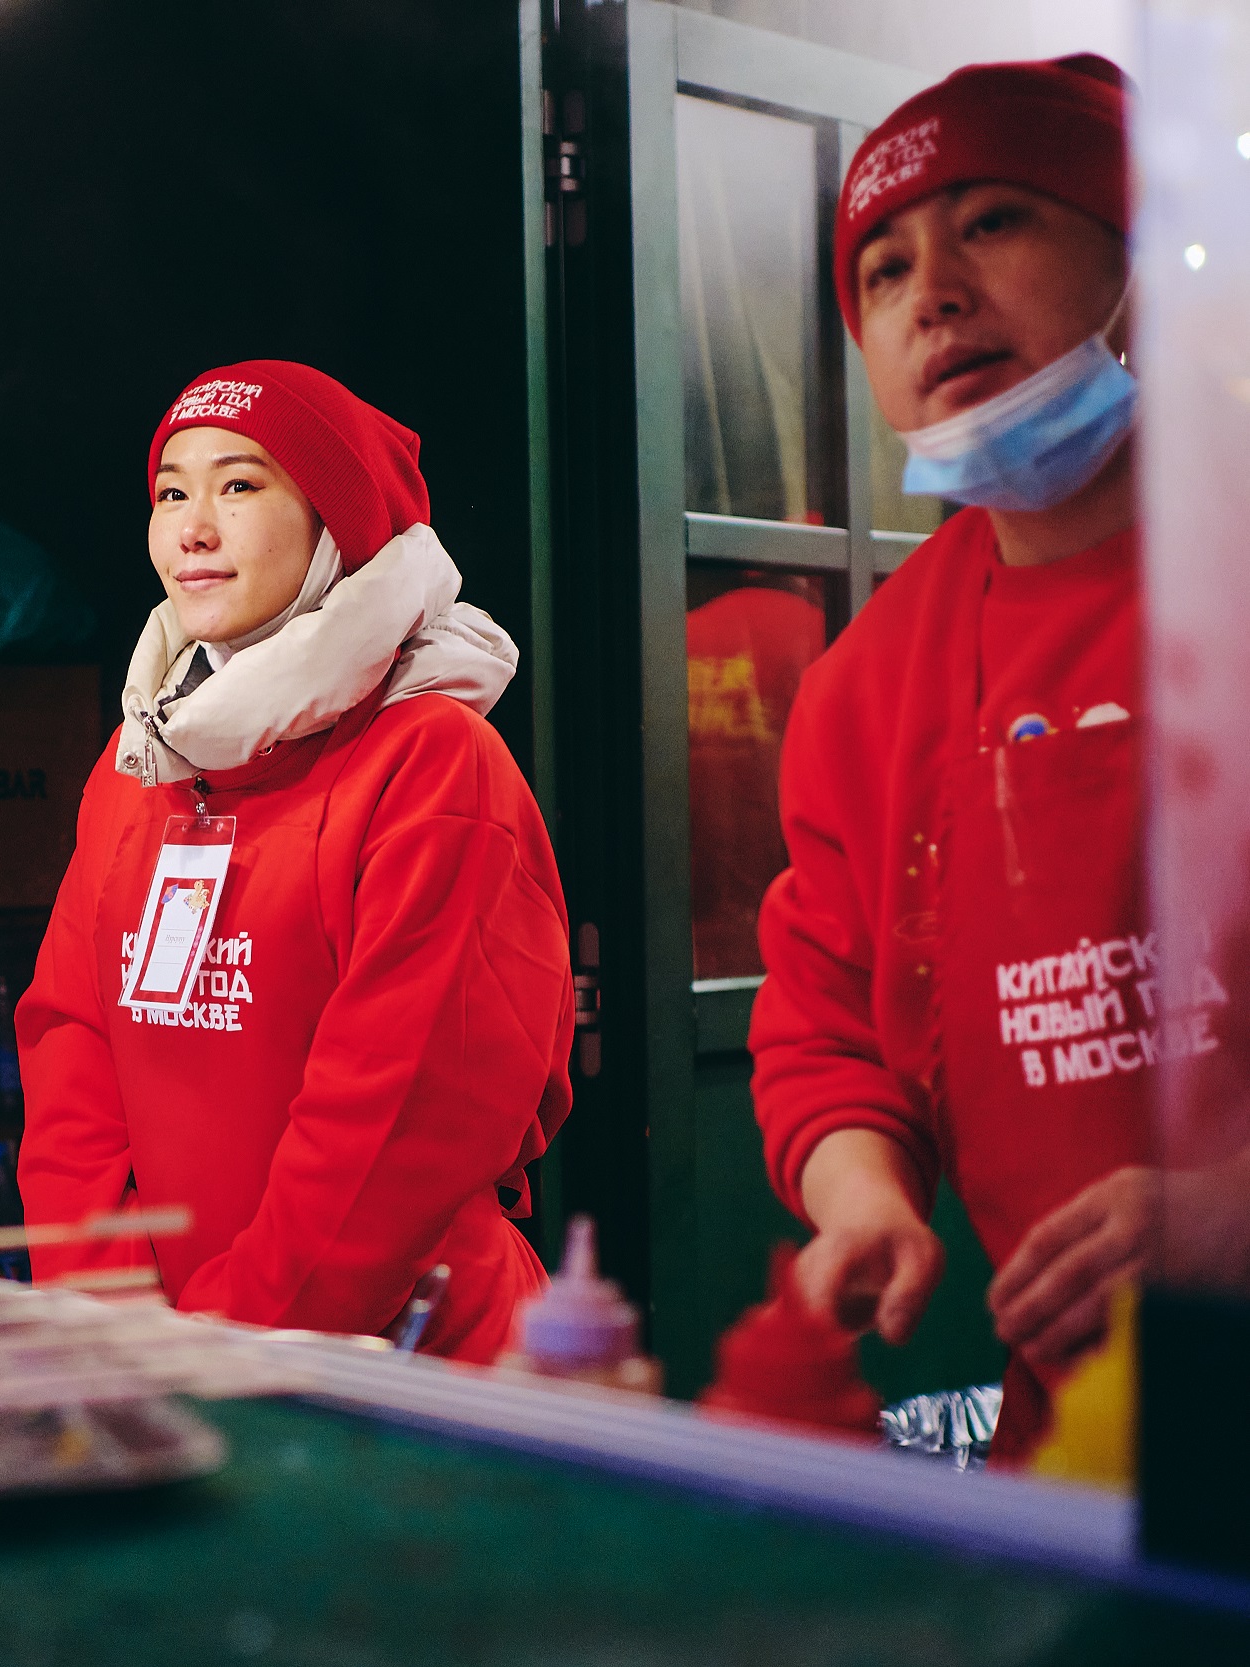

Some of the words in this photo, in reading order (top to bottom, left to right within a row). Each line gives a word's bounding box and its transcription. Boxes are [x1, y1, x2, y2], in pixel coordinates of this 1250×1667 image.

[177, 403, 240, 420] МОСКВЕ
[218, 393, 251, 411] ГОД
[996, 932, 1158, 1001] КИТАЙСК
[198, 969, 253, 1004] ГОД
[147, 1002, 243, 1032] МОСКВЕ
[1000, 986, 1126, 1045] НОВЫЙ
[1021, 1049, 1047, 1087] В
